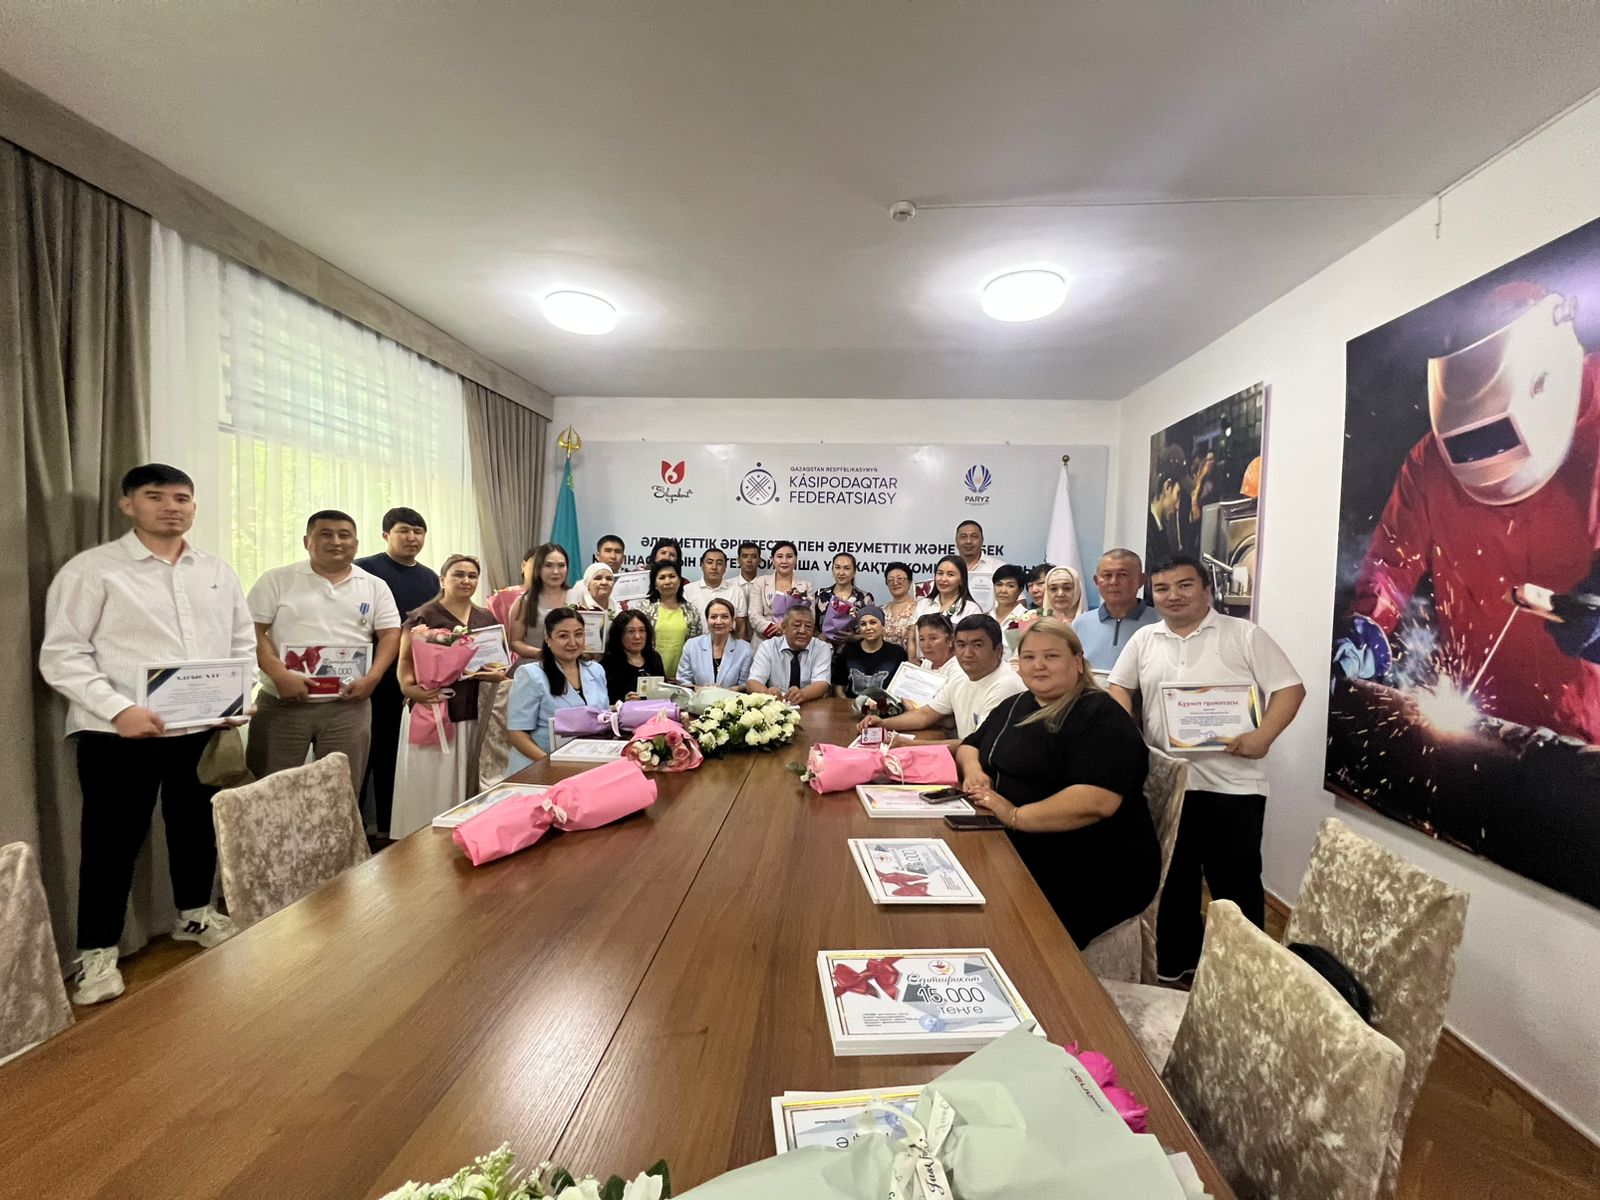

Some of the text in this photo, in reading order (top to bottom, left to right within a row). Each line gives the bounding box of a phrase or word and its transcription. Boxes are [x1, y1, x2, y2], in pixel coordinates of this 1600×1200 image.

[789, 473, 898, 489] KÁSIPODAQTAR
[789, 491, 897, 504] FEDERATSIASY
[798, 541, 824, 552] ПЕН
[828, 542, 911, 554] ӘЛЕУМЕТТІК
[914, 544, 956, 555] ЖӘНЕ
[919, 987, 985, 1003] 15.000
